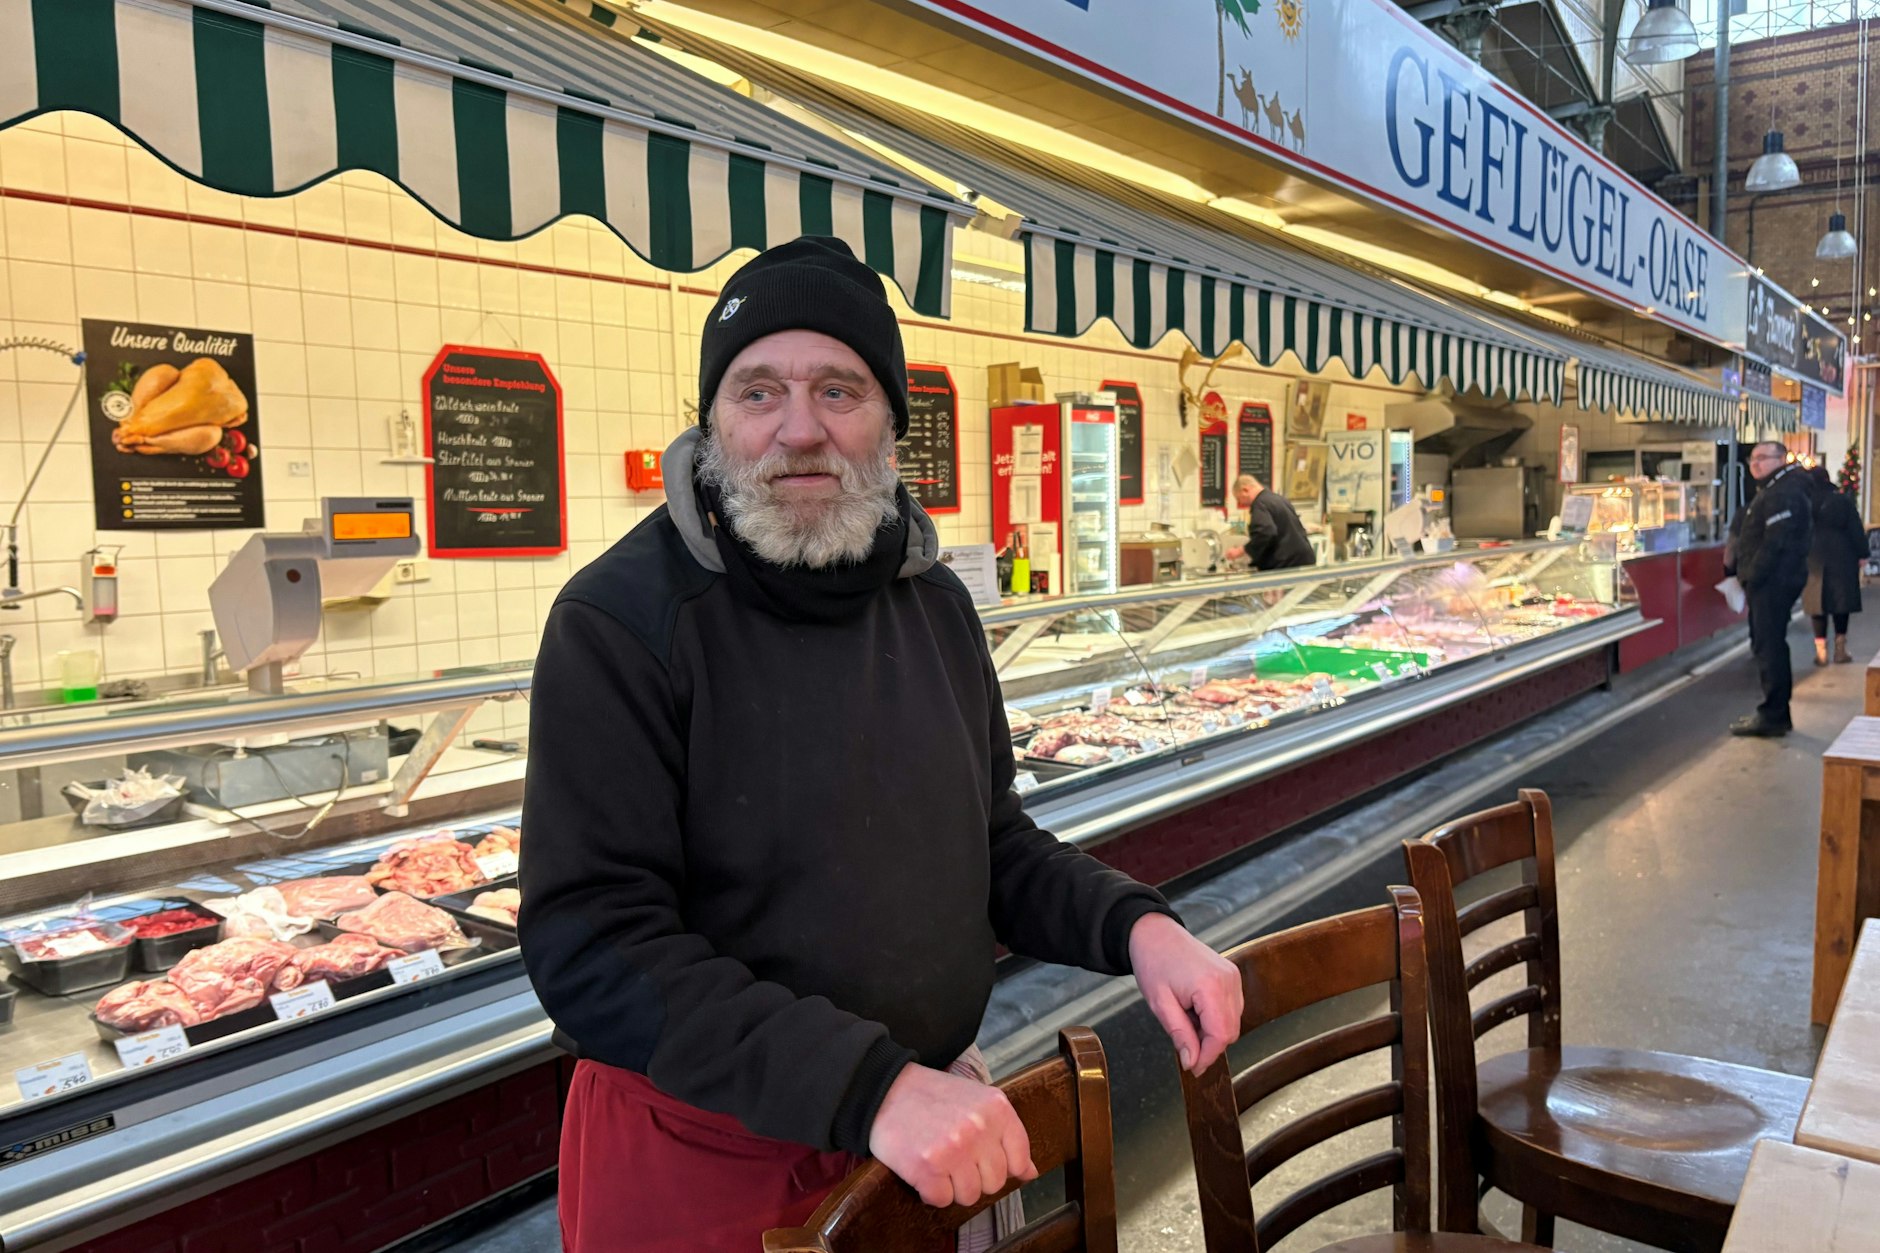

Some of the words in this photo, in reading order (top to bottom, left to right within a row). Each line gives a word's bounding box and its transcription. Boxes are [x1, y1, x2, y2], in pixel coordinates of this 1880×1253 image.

[1385, 45, 1708, 322] GEFLÜGEL-OASE
[110, 326, 168, 350] Unsere
[173, 331, 237, 356] Qualität
